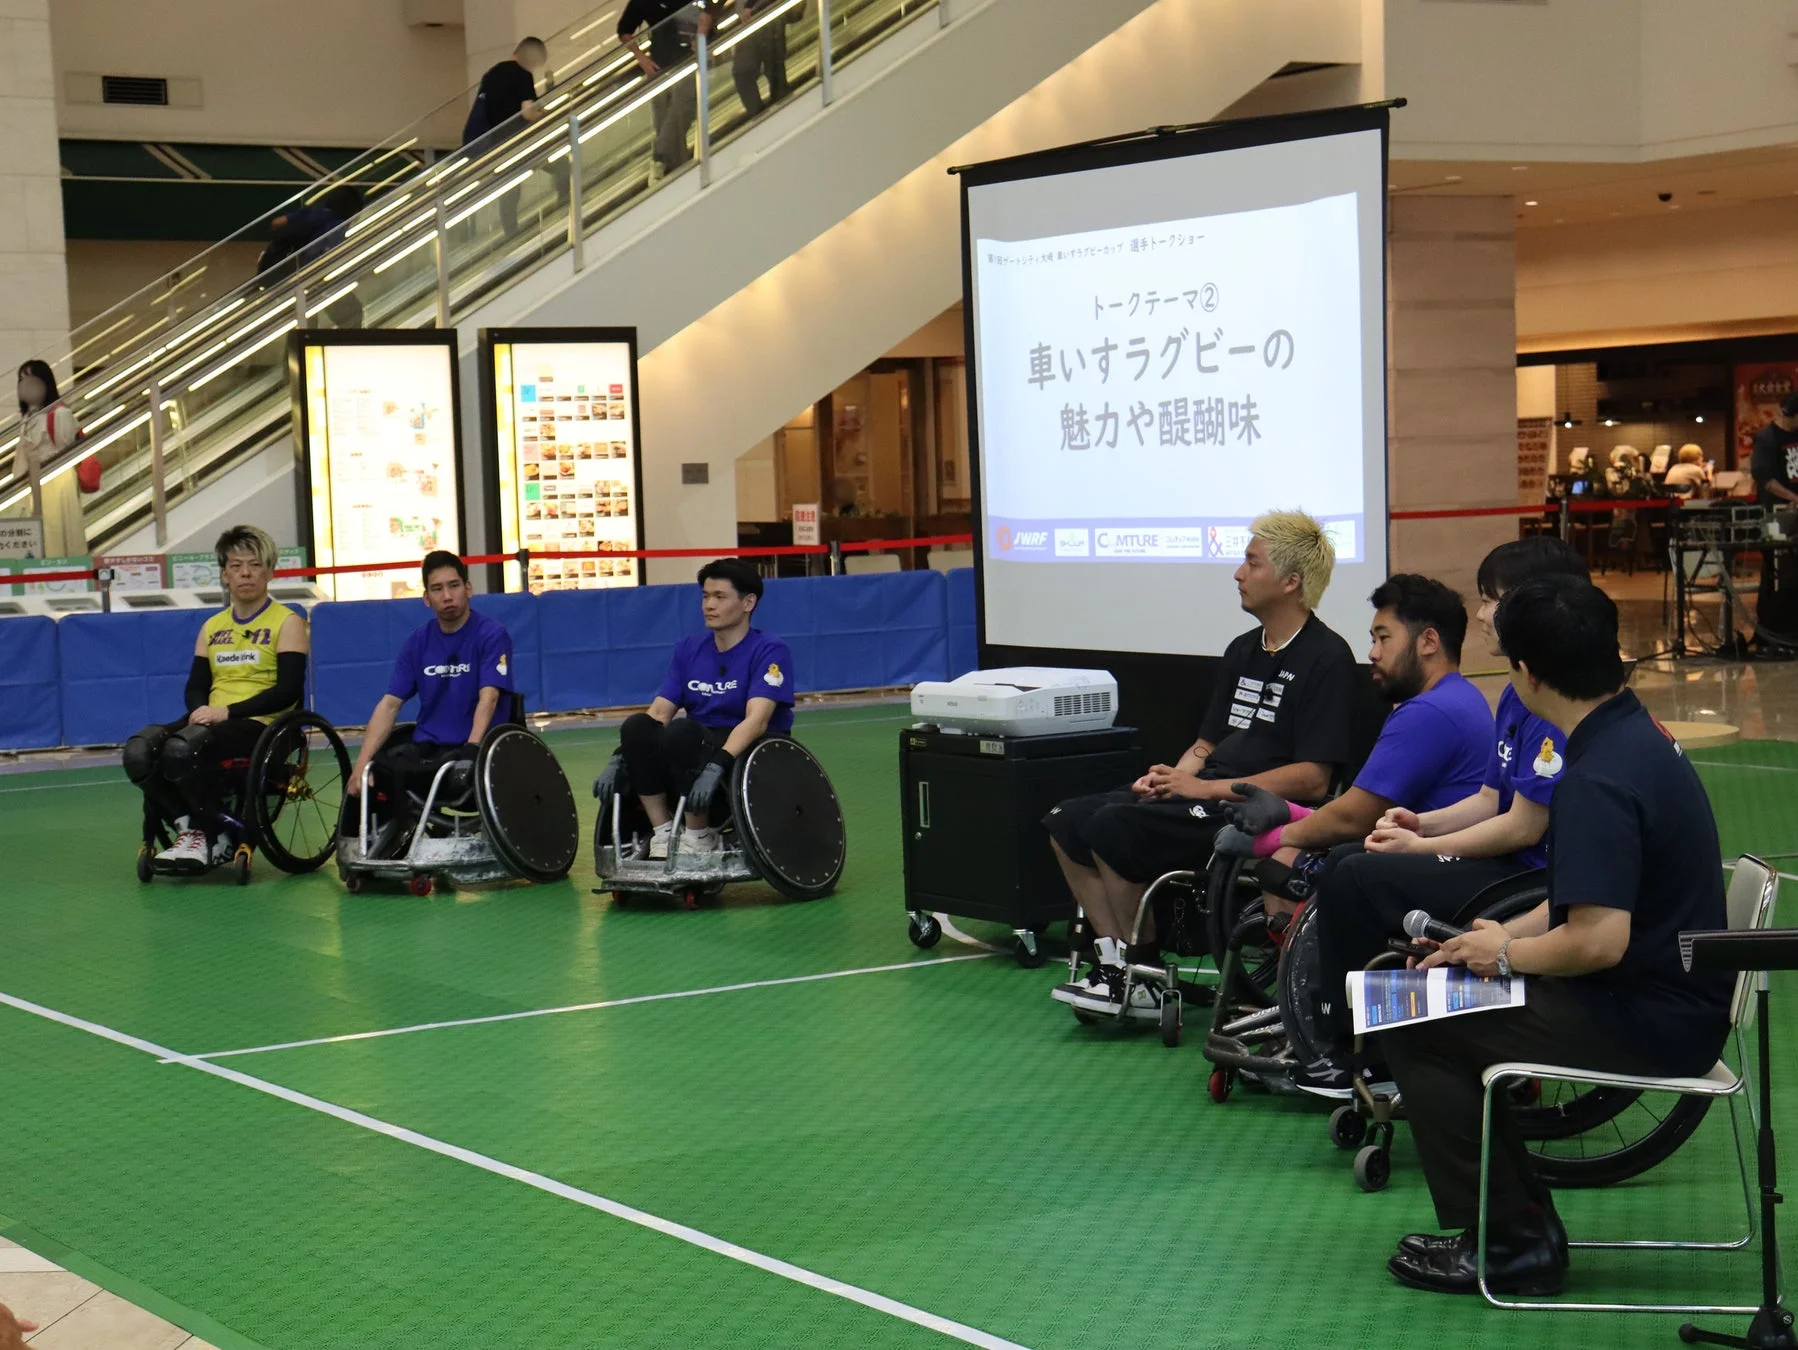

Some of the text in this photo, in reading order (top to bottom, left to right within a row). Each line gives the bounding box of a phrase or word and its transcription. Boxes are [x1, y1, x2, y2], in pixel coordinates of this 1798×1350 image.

[1130, 233, 1205, 252] 選手トークショー
[1095, 282, 1219, 321] トークテーマ②
[1028, 327, 1294, 391] 車いすラグビーの
[1060, 393, 1262, 451] 魅力や醍醐味
[1014, 532, 1048, 546] JWRF
